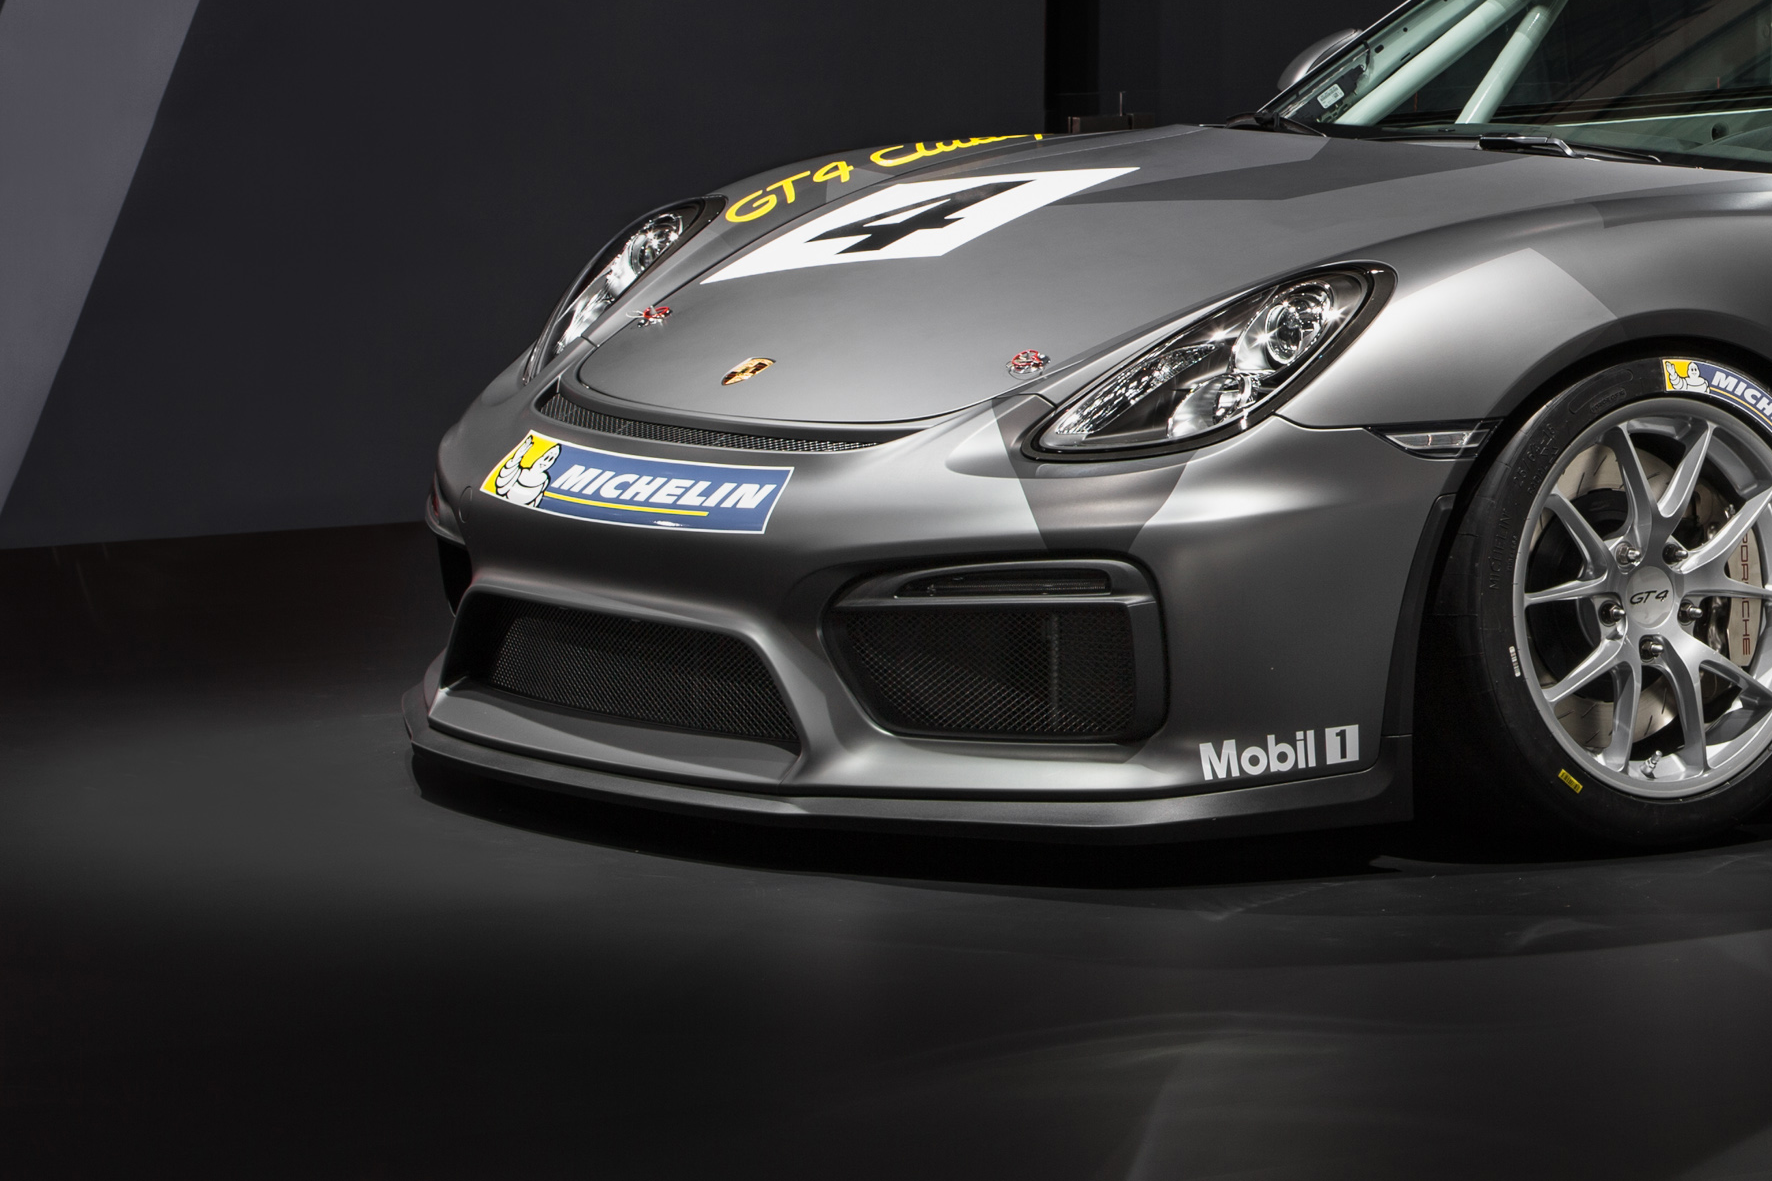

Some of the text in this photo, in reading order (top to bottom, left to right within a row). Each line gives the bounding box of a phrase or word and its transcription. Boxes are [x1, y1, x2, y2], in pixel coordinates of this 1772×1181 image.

[725, 161, 854, 223] GT4
[803, 179, 1037, 255] 4
[550, 464, 777, 509] MICHELIN
[1741, 532, 1750, 655] PORCHE
[1199, 730, 1317, 782] Mobil
